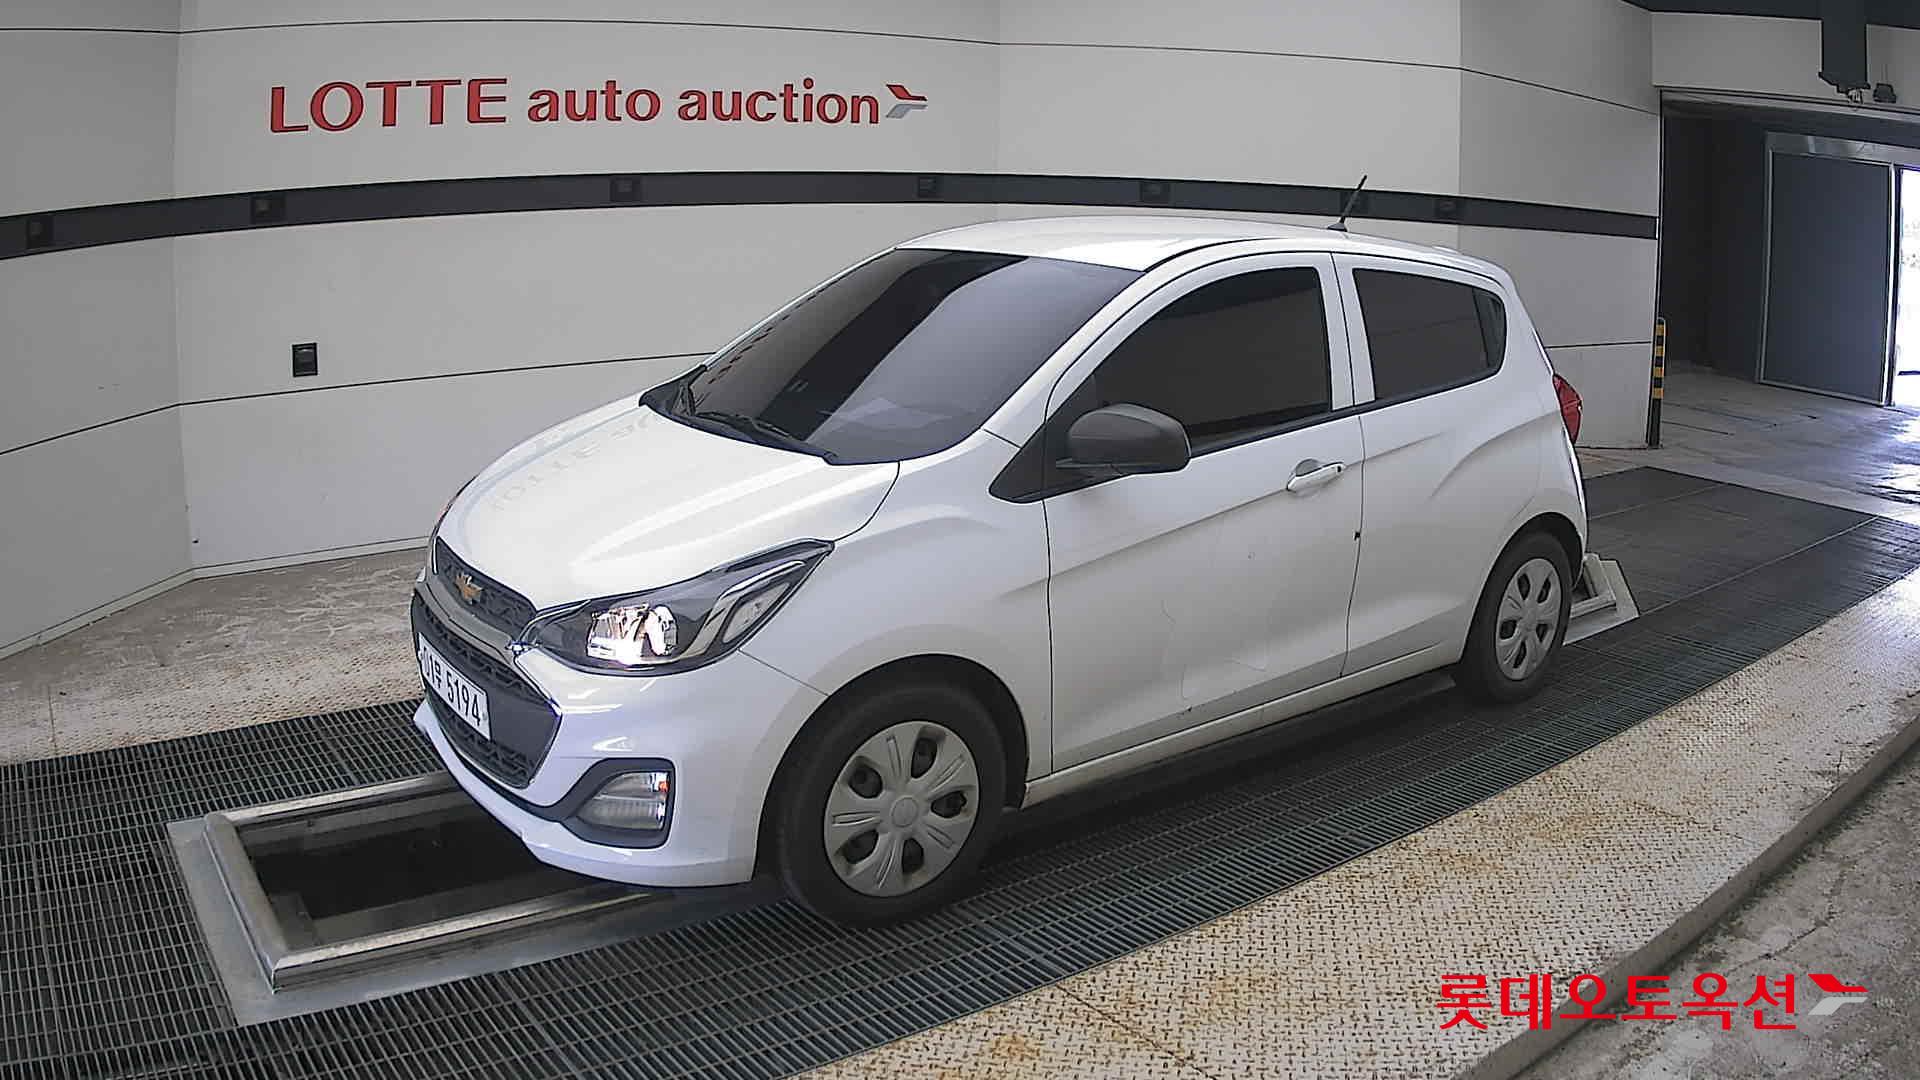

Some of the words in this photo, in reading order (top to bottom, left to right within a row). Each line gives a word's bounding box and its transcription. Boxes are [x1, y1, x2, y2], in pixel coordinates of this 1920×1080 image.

[270, 79, 507, 133] LOTTE
[527, 79, 661, 123] auto
[678, 77, 879, 124] auction
[446, 670, 481, 727] 5194
